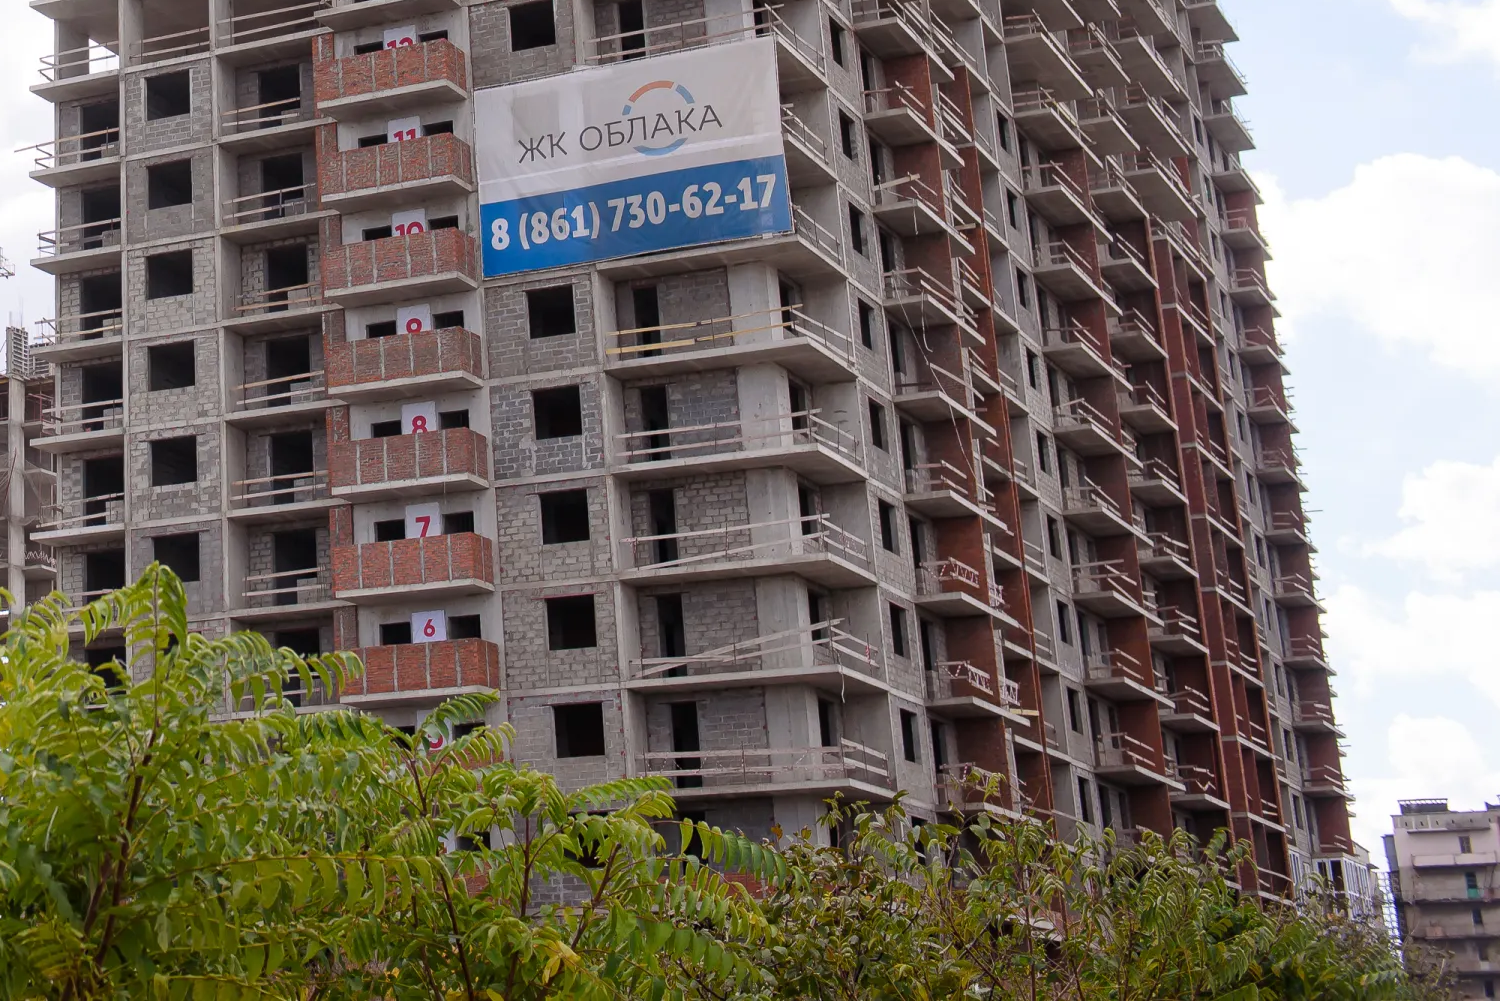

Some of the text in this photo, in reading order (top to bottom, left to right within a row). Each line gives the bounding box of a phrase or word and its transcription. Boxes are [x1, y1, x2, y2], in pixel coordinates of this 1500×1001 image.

[518, 104, 723, 164] ЖК ОБЛАКА
[491, 173, 776, 250] 8 (861) 730-62-17
[411, 415, 428, 435] 8
[415, 515, 431, 538] 7
[423, 618, 436, 638] 6
